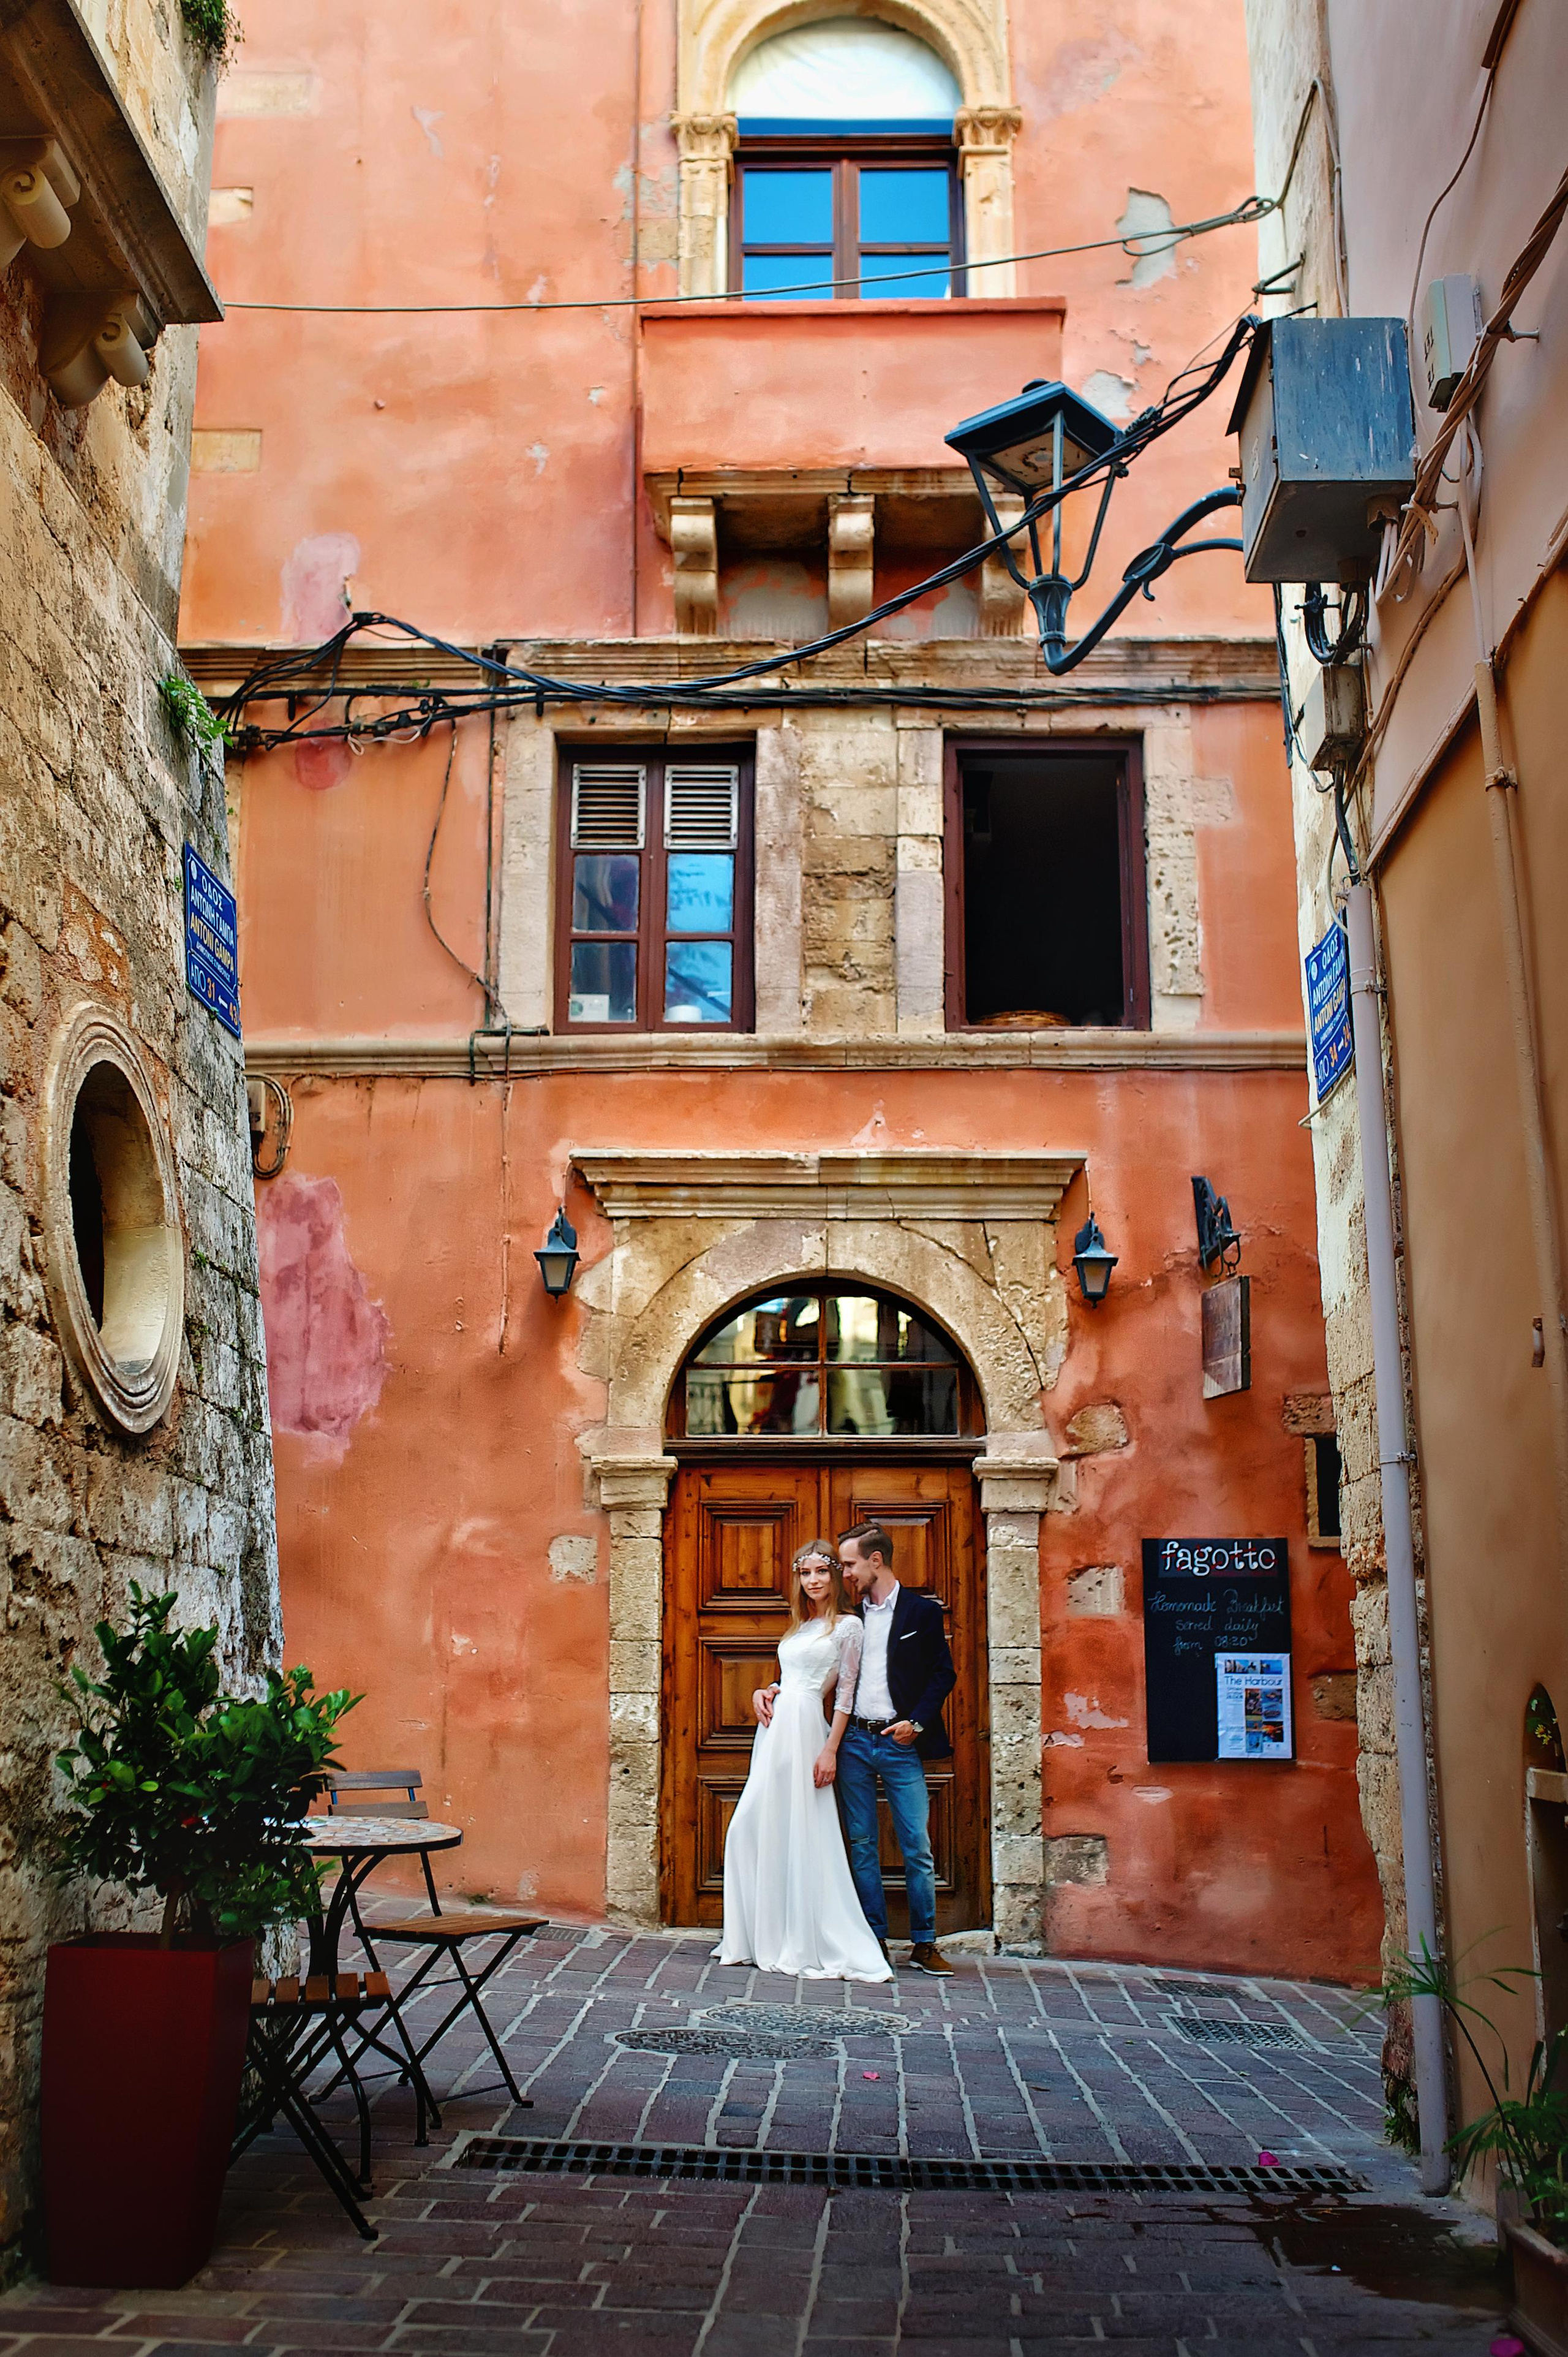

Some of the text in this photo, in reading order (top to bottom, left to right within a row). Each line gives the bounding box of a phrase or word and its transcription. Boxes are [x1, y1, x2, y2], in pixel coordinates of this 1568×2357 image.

[202, 875, 224, 912] ΟΔΟΣ
[190, 885, 235, 949] ΑΝΤΩΝΗ ΓΑΜΠΑ
[190, 912, 234, 974] ANTONI GAMPA
[1322, 933, 1338, 970] ΟΔΟΣ
[191, 962, 238, 1026] ΑΠΟ 31 43
[1313, 966, 1333, 1010] ΑΝΤΩΝΗ
[1314, 1001, 1333, 1036] ANTONI
[1317, 1054, 1329, 1086] ΑΠΟ
[1161, 1541, 1276, 1576] fagotto
[1175, 1616, 1259, 1641] served daily
[1224, 1676, 1283, 1686] The Harbour
